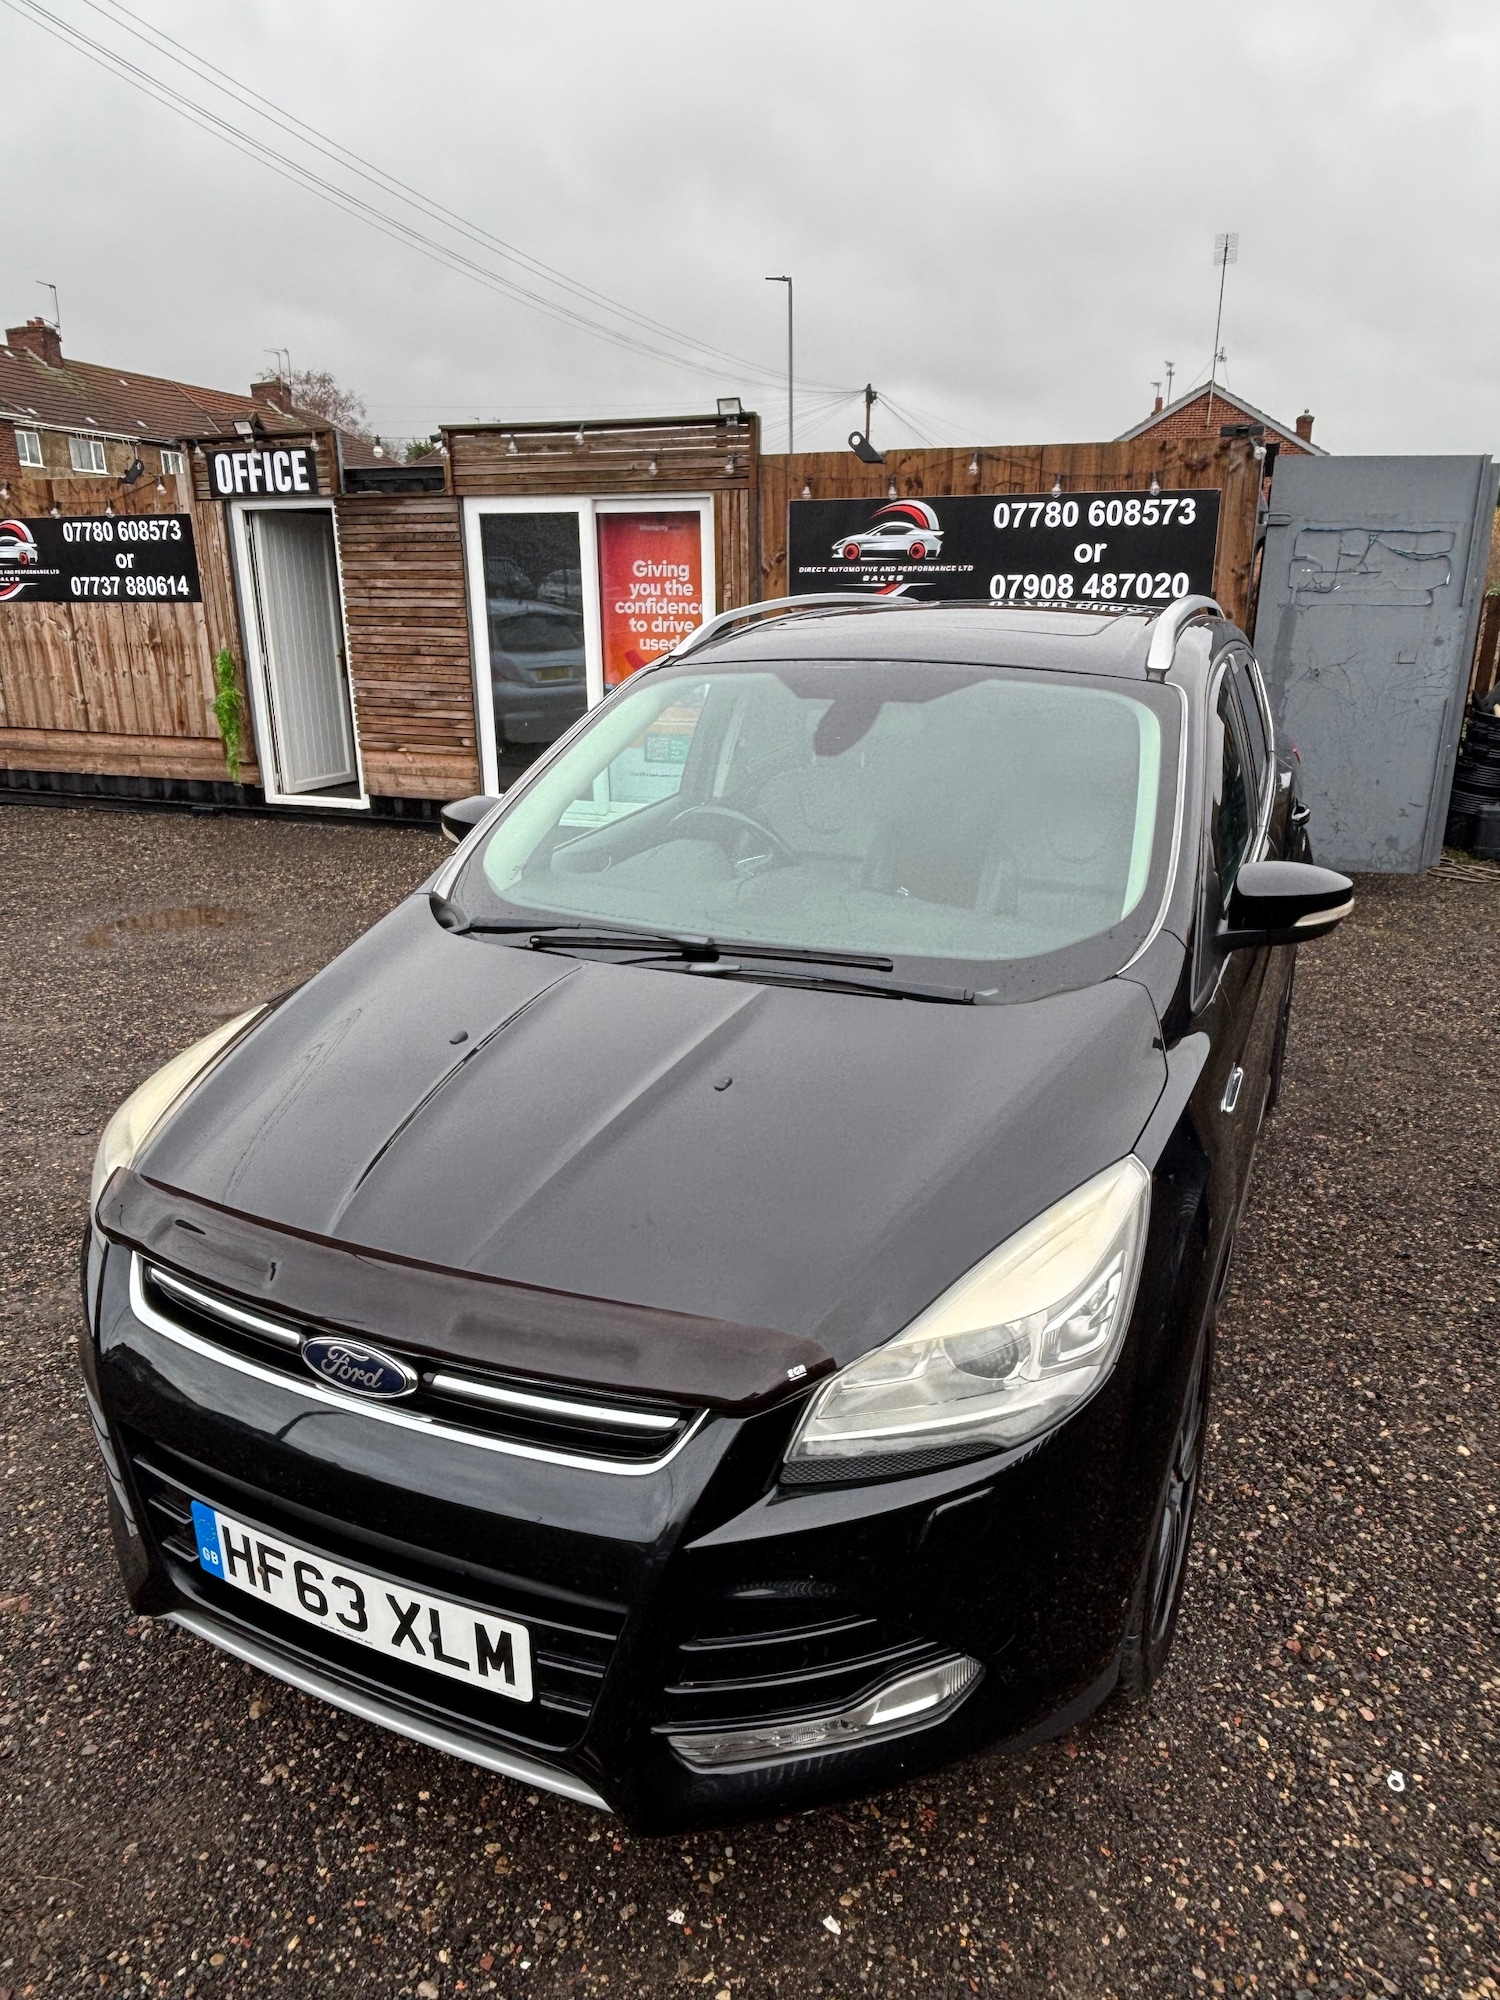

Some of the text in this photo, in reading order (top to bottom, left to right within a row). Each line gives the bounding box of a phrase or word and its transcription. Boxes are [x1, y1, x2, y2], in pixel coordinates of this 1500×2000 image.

[215, 450, 310, 494] OFFICE
[992, 498, 1197, 529] 07780 608573
[62, 519, 182, 543] 07780 608573
[115, 553, 135, 569] or
[1073, 542, 1108, 564] or
[632, 560, 690, 581] Giving
[897, 565, 957, 573] PERFORMANCE
[70, 575, 190, 597] 07737 880614
[629, 579, 694, 599] you the
[989, 571, 1190, 600] 07908 487020
[628, 616, 695, 632] to drive
[639, 635, 680, 651] used
[320, 1345, 385, 1389] Ford
[202, 1547, 219, 1566] GB
[221, 1524, 516, 1686] HF63 XLM
